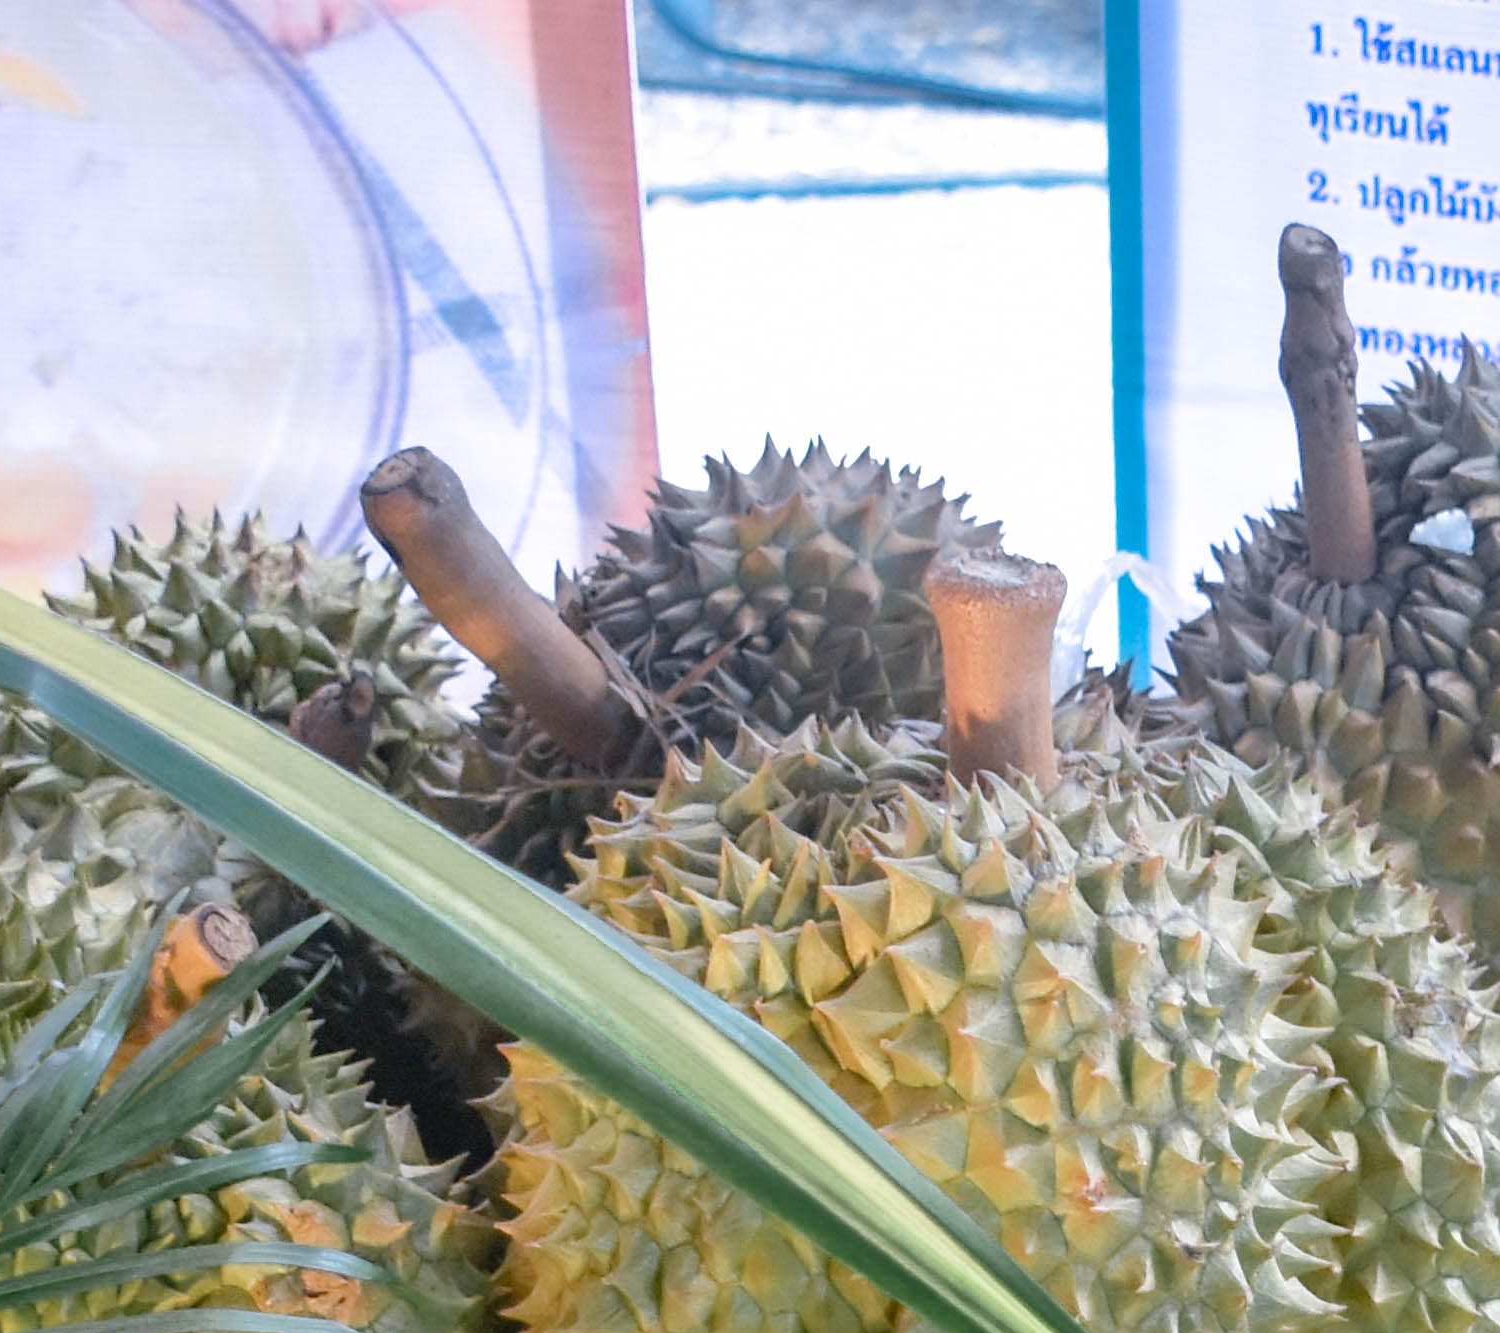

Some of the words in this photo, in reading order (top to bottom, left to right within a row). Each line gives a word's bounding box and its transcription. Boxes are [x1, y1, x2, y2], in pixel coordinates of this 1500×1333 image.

[1309, 23, 1340, 58] 1.
[1305, 92, 1451, 146] ทุเรียนได้
[1306, 170, 1341, 204] 2.
